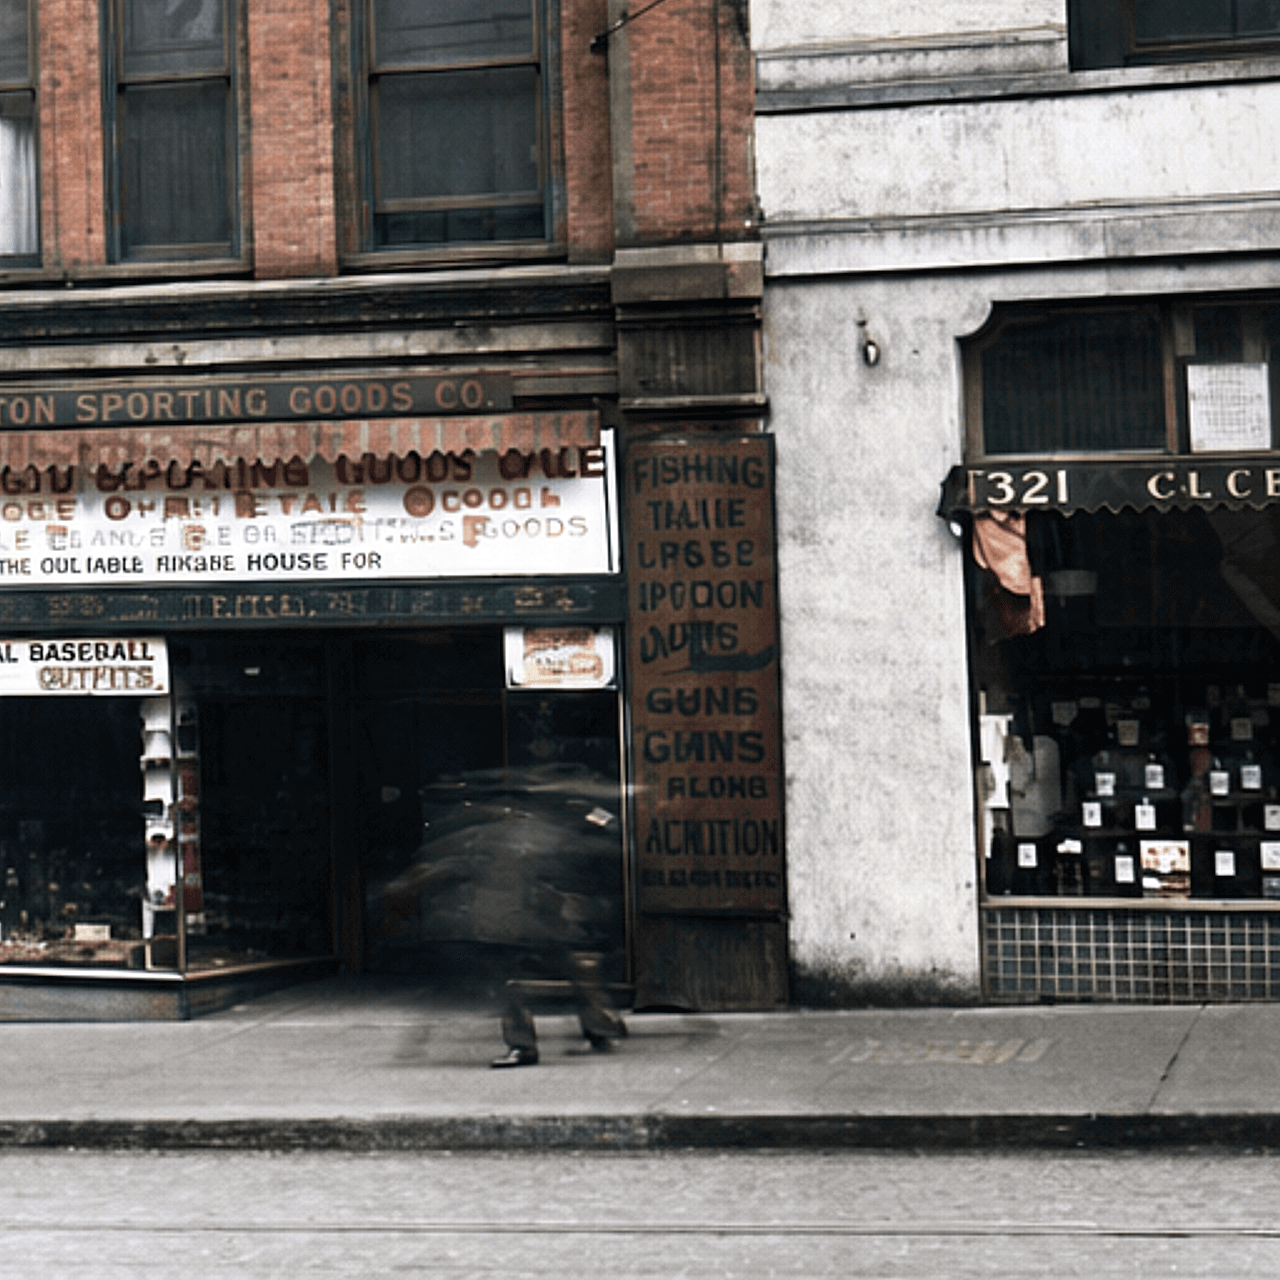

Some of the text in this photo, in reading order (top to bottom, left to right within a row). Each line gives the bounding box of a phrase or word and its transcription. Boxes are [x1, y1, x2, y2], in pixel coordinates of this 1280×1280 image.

[76, 388, 269, 422] SPORTING
[289, 382, 414, 416] GOODS
[435, 380, 496, 410] CO.
[986, 469, 1069, 505] 321
[246, 552, 330, 571] HOUSE
[340, 551, 383, 570] FOR
[28, 641, 156, 663] BASEBALL
